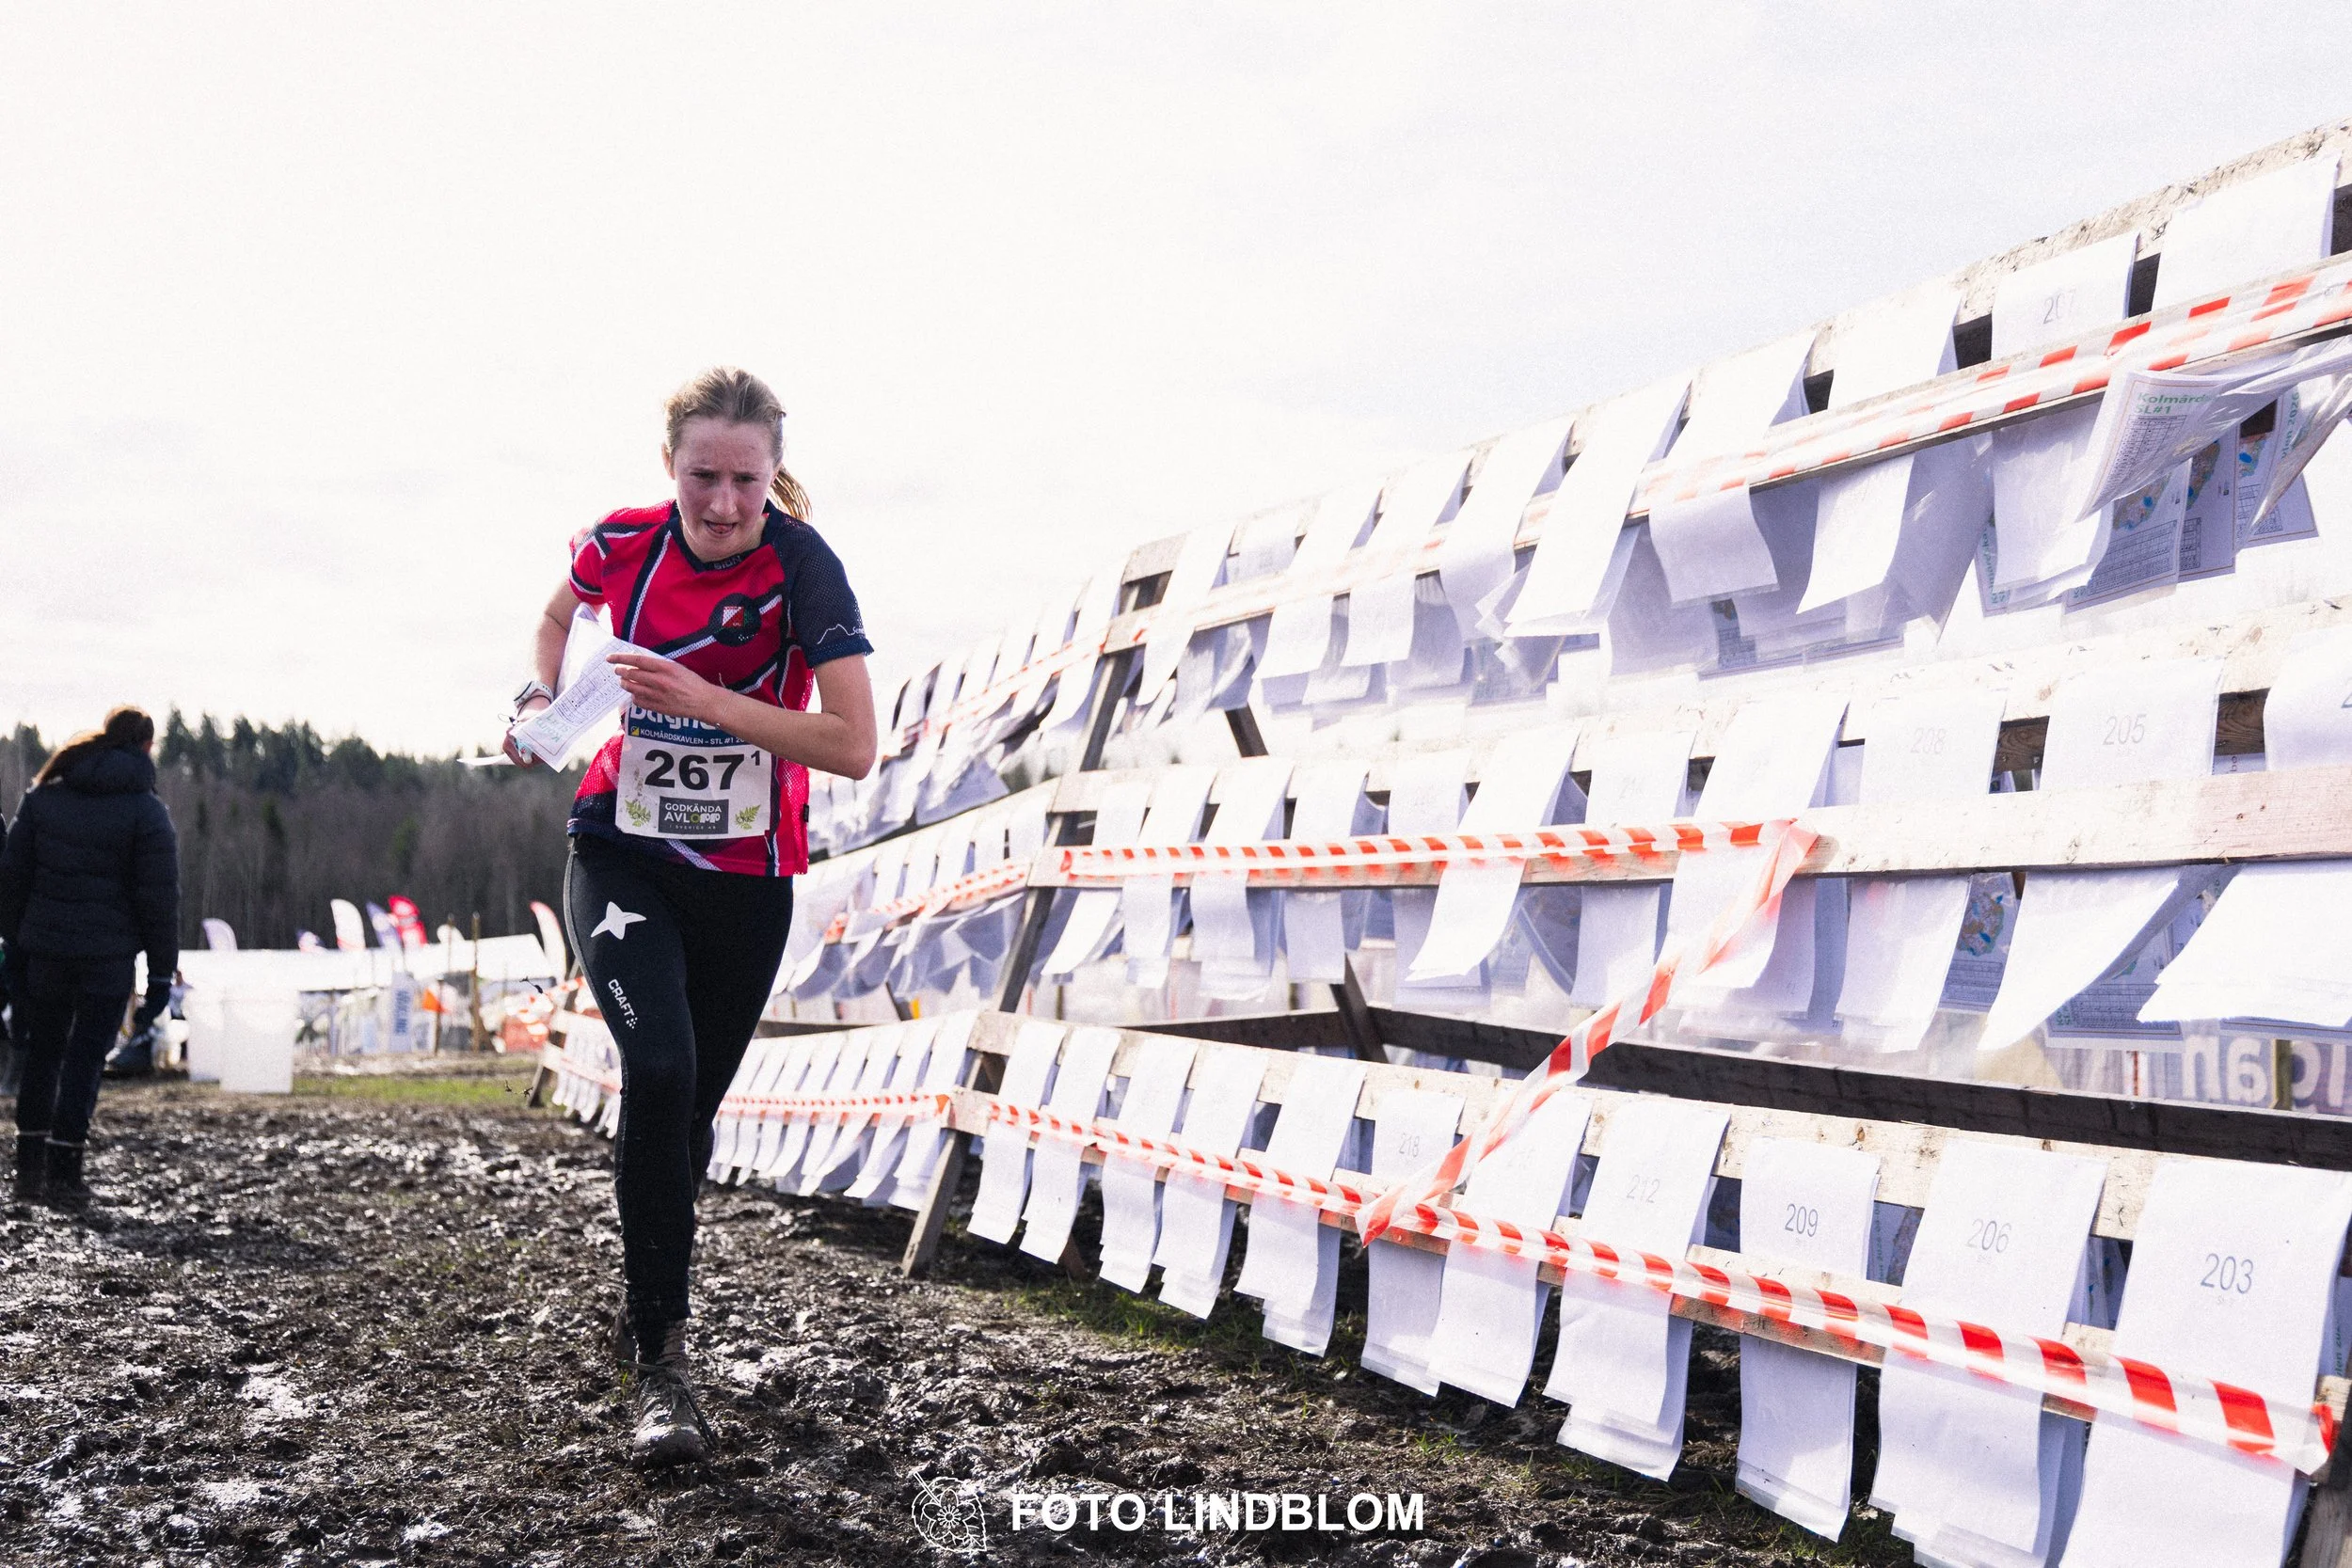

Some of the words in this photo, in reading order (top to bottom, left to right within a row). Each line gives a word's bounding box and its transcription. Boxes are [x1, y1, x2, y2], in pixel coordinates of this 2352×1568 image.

[1910, 726, 1947, 756] 208
[2103, 714, 2146, 748] 205
[644, 749, 745, 791] 267
[750, 750, 761, 767] 1
[663, 812, 722, 825] AVLOPP
[664, 801, 723, 815] GODKÄNDA
[608, 978, 635, 1017] CRAFT
[1626, 1174, 1661, 1205] 212
[1784, 1203, 1820, 1238] 209
[1966, 1218, 2012, 1254] 206
[2200, 1253, 2254, 1295] 203
